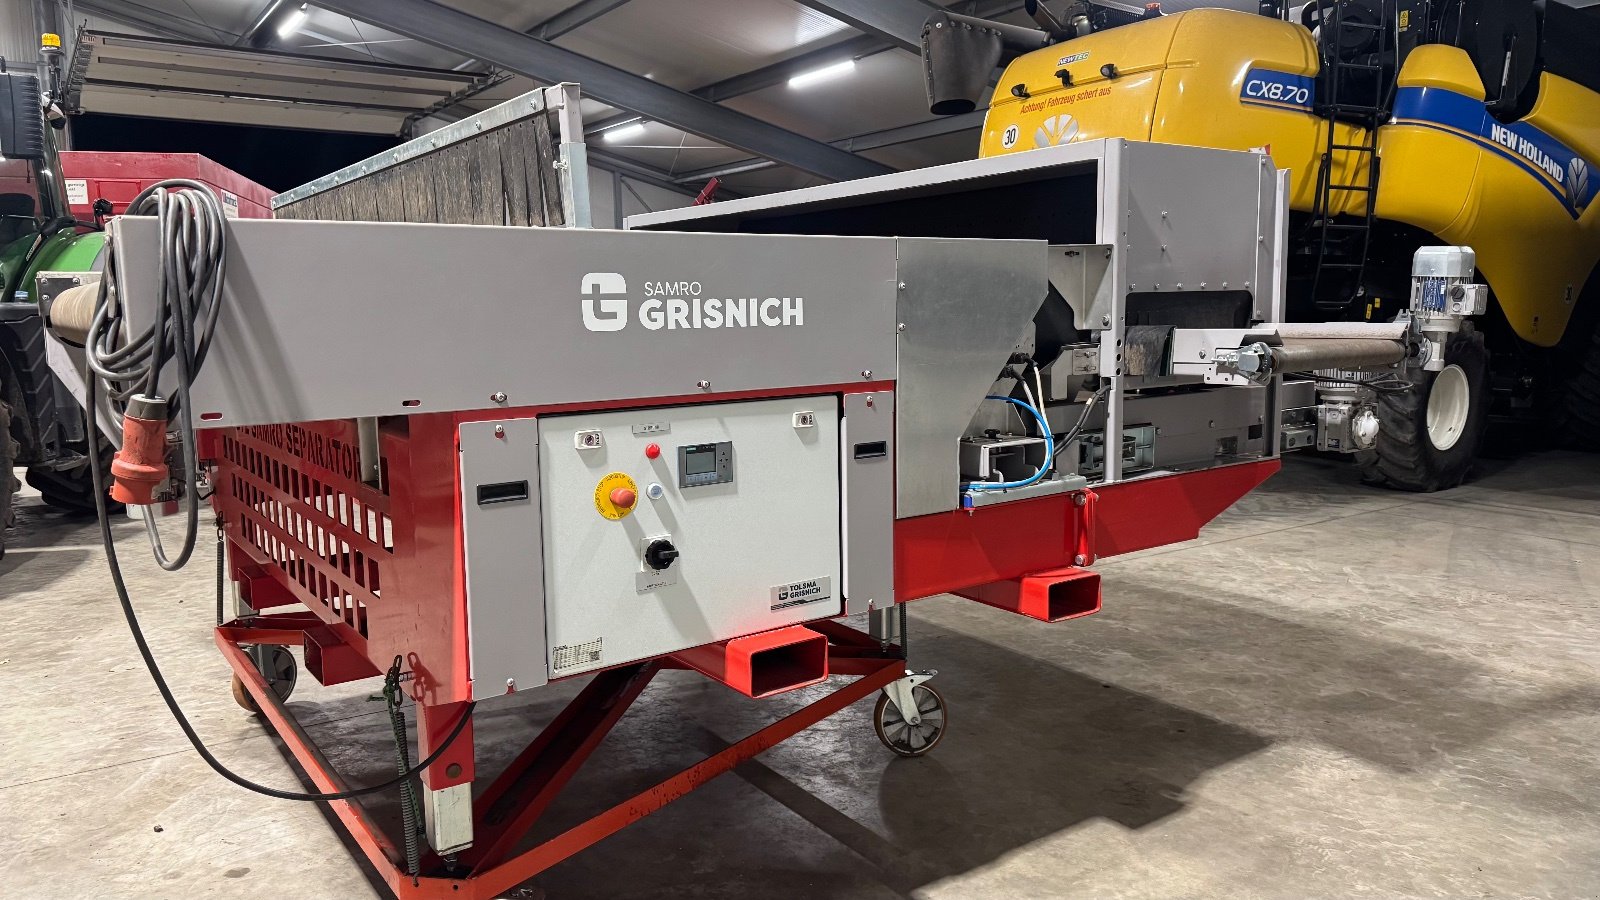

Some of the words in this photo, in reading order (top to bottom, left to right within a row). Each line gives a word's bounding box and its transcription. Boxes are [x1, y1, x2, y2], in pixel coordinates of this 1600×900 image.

[1058, 52, 1089, 65] NEWTEC
[1020, 99, 1047, 114] Achtung!
[1047, 94, 1076, 108] Fahrzeug
[1076, 88, 1098, 101] schert
[1099, 87, 1112, 96] aus
[1246, 80, 1309, 103] CX8.70
[1004, 128, 1017, 146] 30
[1491, 123, 1518, 150] NEW
[1518, 137, 1564, 183] HOLLAND
[644, 281, 702, 297] SAMRO
[638, 297, 804, 331] GRISNICH
[790, 581, 817, 591] TOLSMA
[790, 587, 821, 598] GRISNICH
